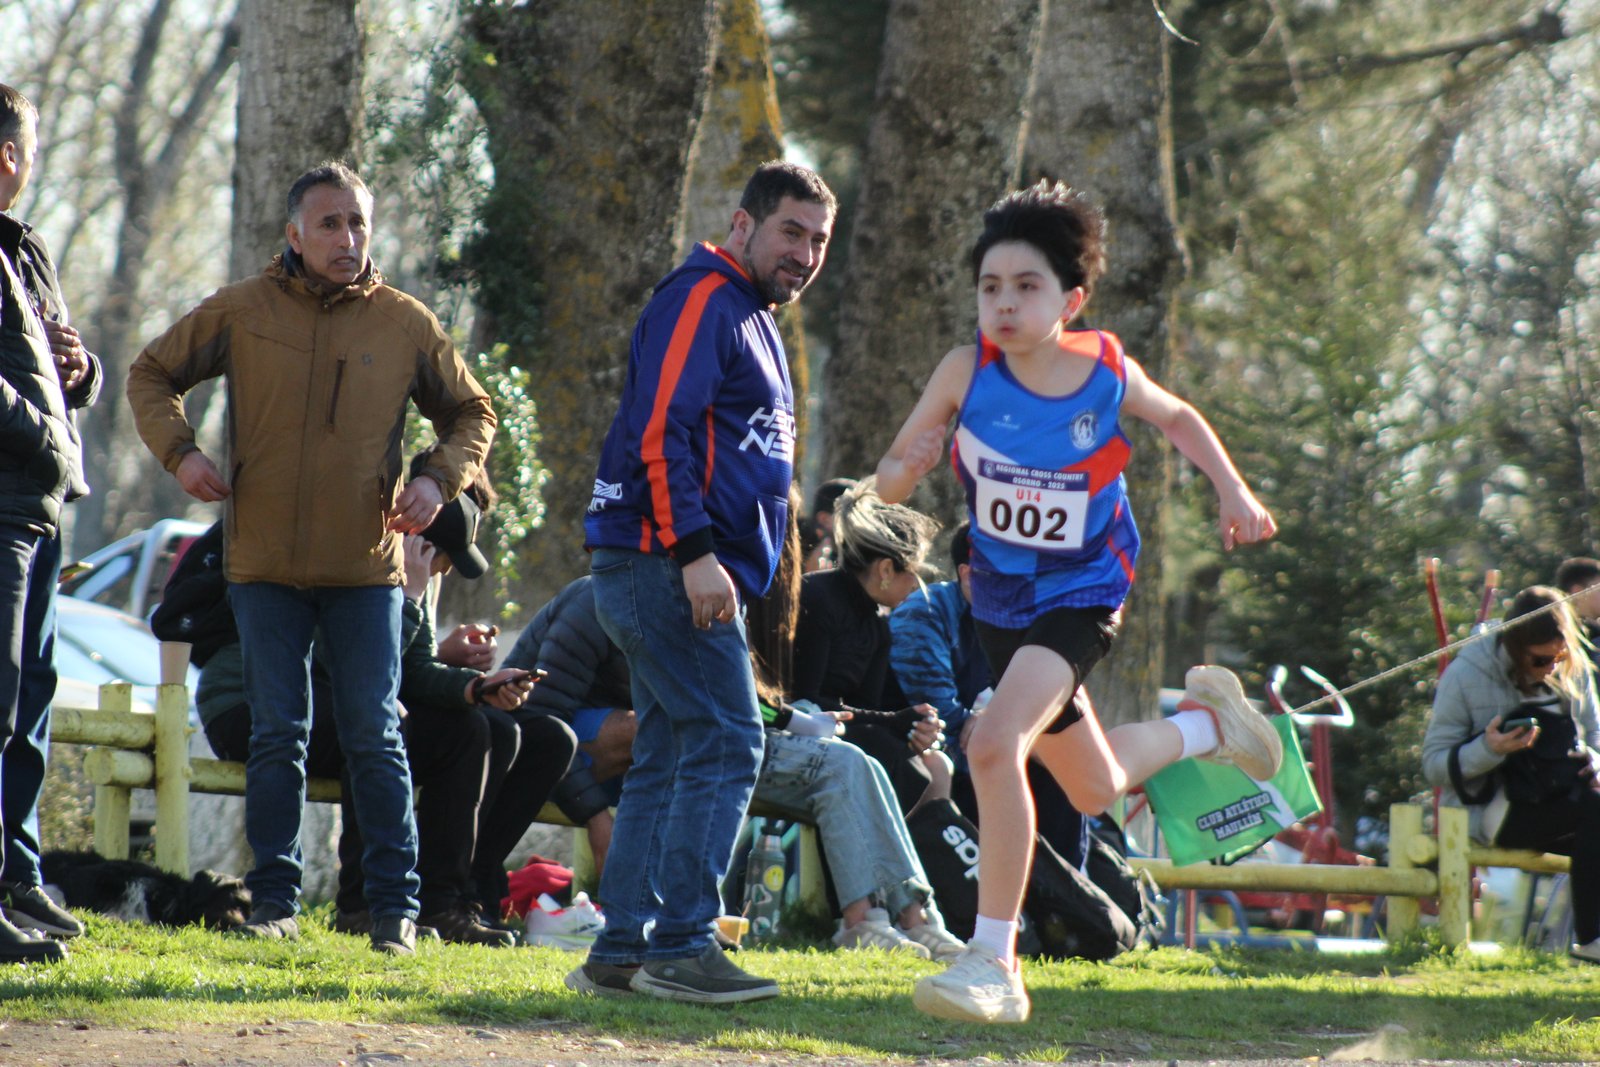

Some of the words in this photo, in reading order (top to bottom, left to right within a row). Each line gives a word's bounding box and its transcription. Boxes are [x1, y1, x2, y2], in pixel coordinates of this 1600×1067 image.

[996, 464, 1029, 475] REGIONAL
[1031, 469, 1052, 479] CROSS
[1054, 472, 1084, 481] COUNTRY
[1013, 477, 1041, 487] OSORNO
[1048, 481, 1066, 489] 2025
[1016, 488, 1041, 502] U14
[990, 498, 1068, 541] 002
[1198, 810, 1224, 830] CLUB
